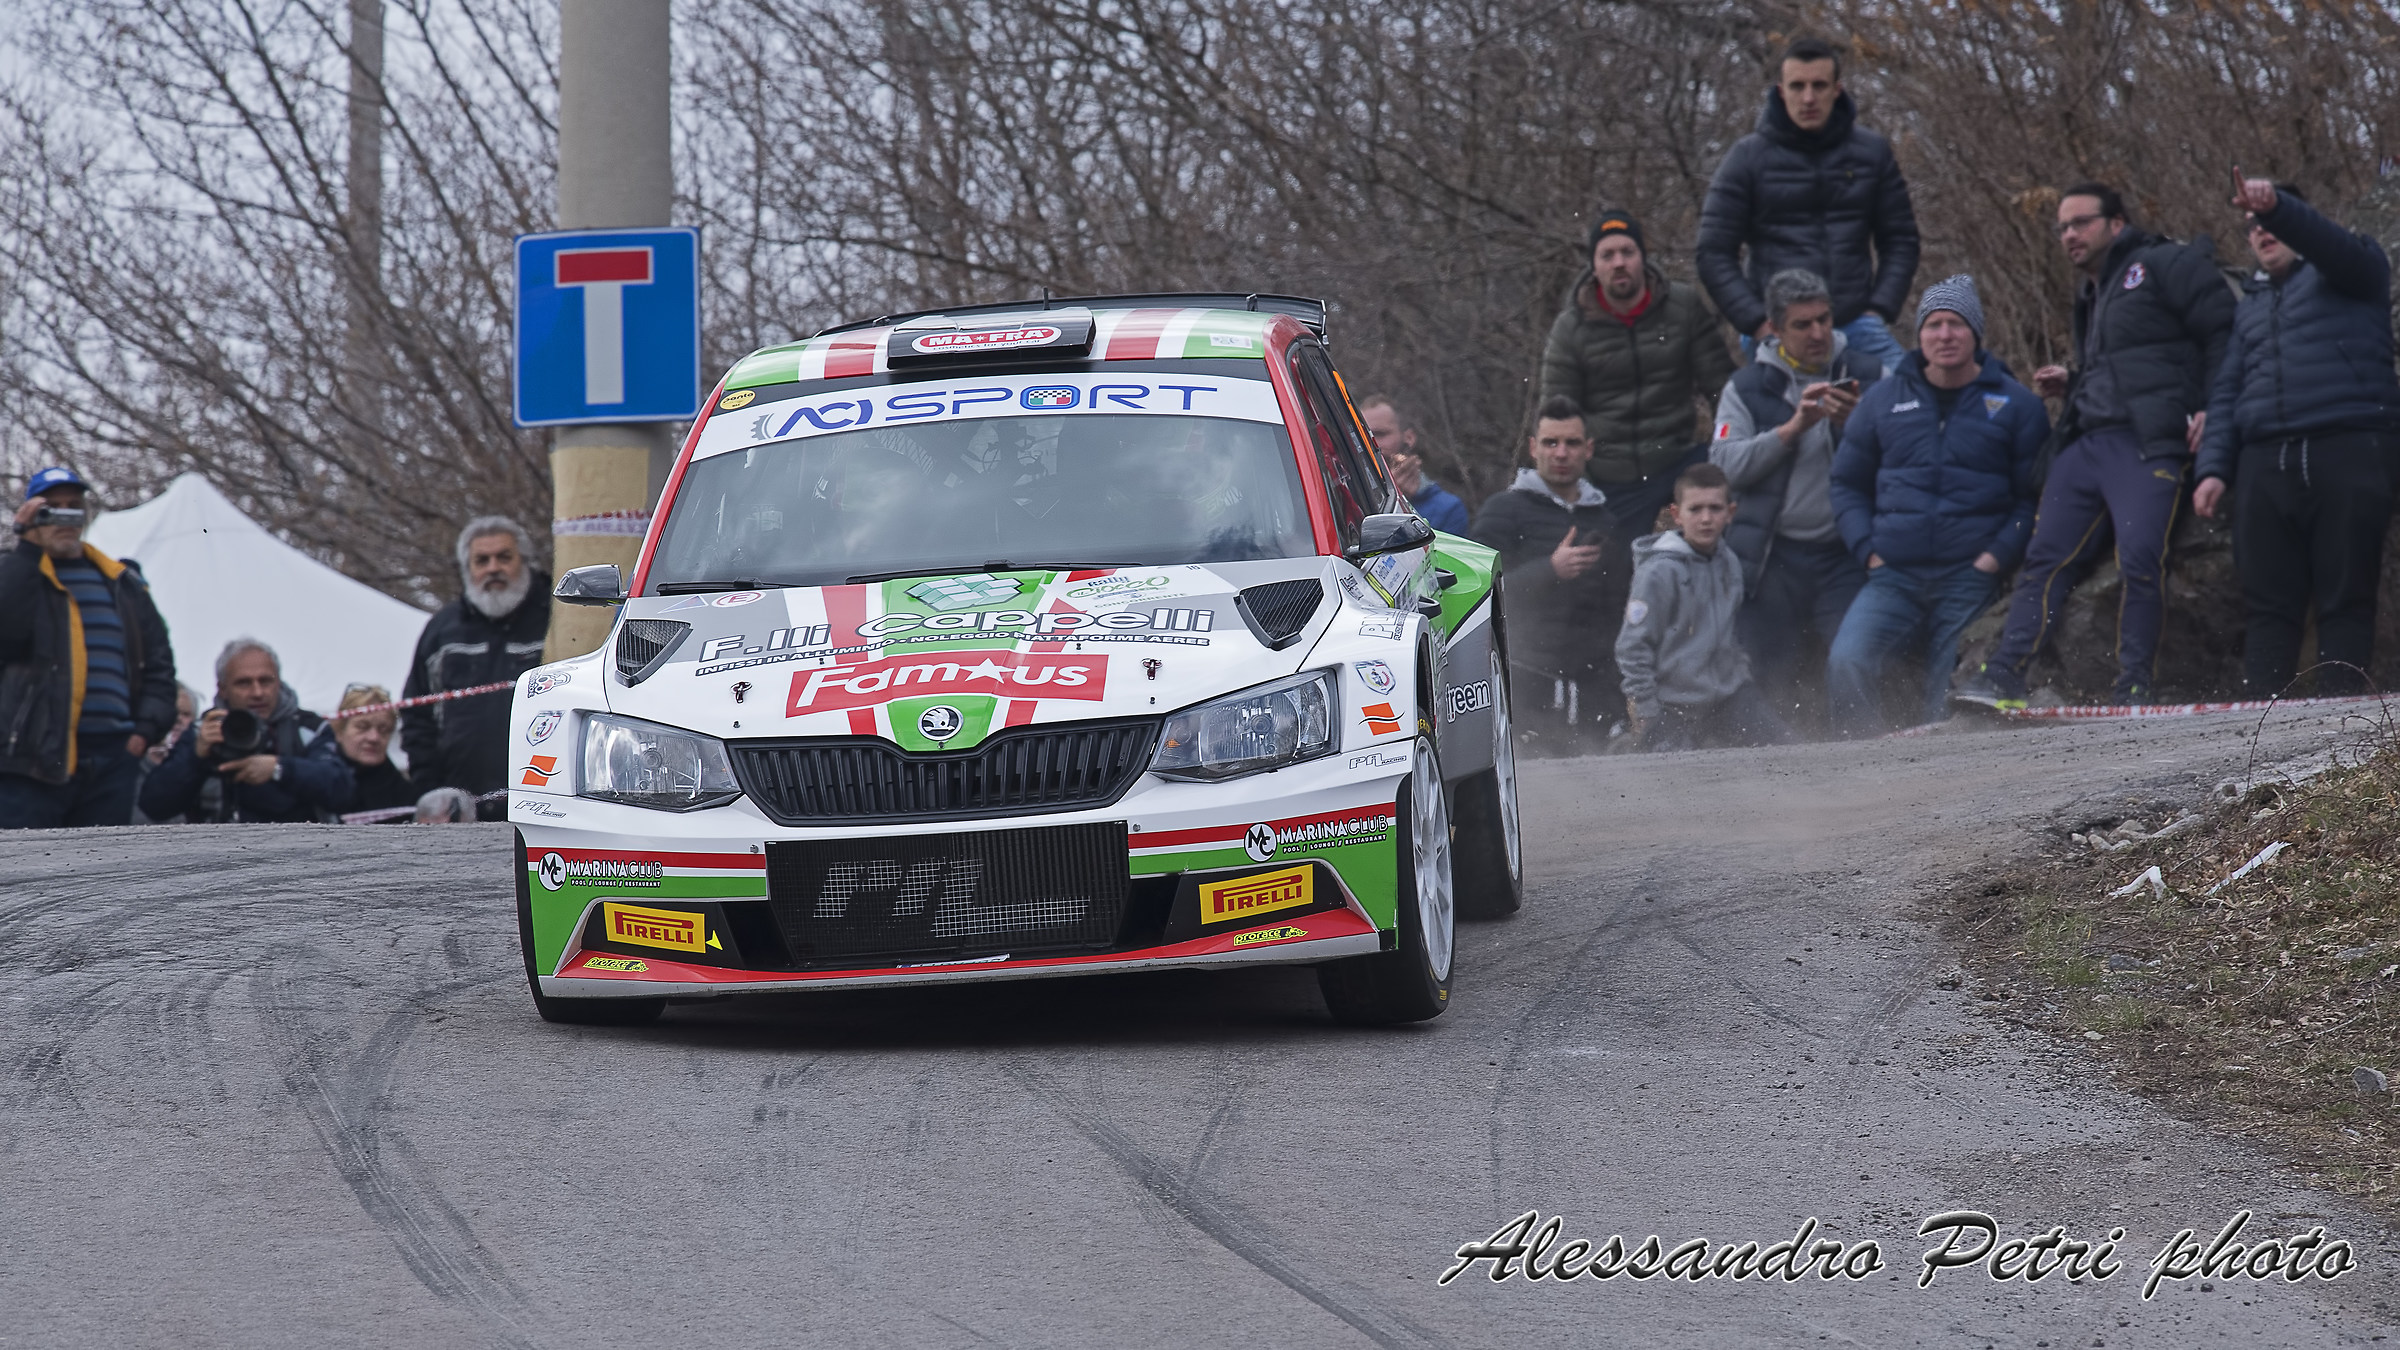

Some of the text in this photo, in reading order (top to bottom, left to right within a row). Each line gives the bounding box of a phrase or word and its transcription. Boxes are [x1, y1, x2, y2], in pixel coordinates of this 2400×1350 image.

[886, 384, 1218, 421] SPORT
[855, 607, 1215, 638] Cappelli
[695, 631, 1210, 676] INFISSI IN ALLUMINIO NOLEGGIO PIATTAFORME AEREE
[1283, 846, 1300, 854] POOL
[1309, 842, 1335, 850] LOUNGE
[1344, 834, 1387, 845] RESTAURANT
[594, 879, 617, 887] LOUNGE
[624, 880, 661, 888] RESTAURANT
[1212, 874, 1303, 915] PIRELLI
[614, 911, 694, 944] PIRELLI
